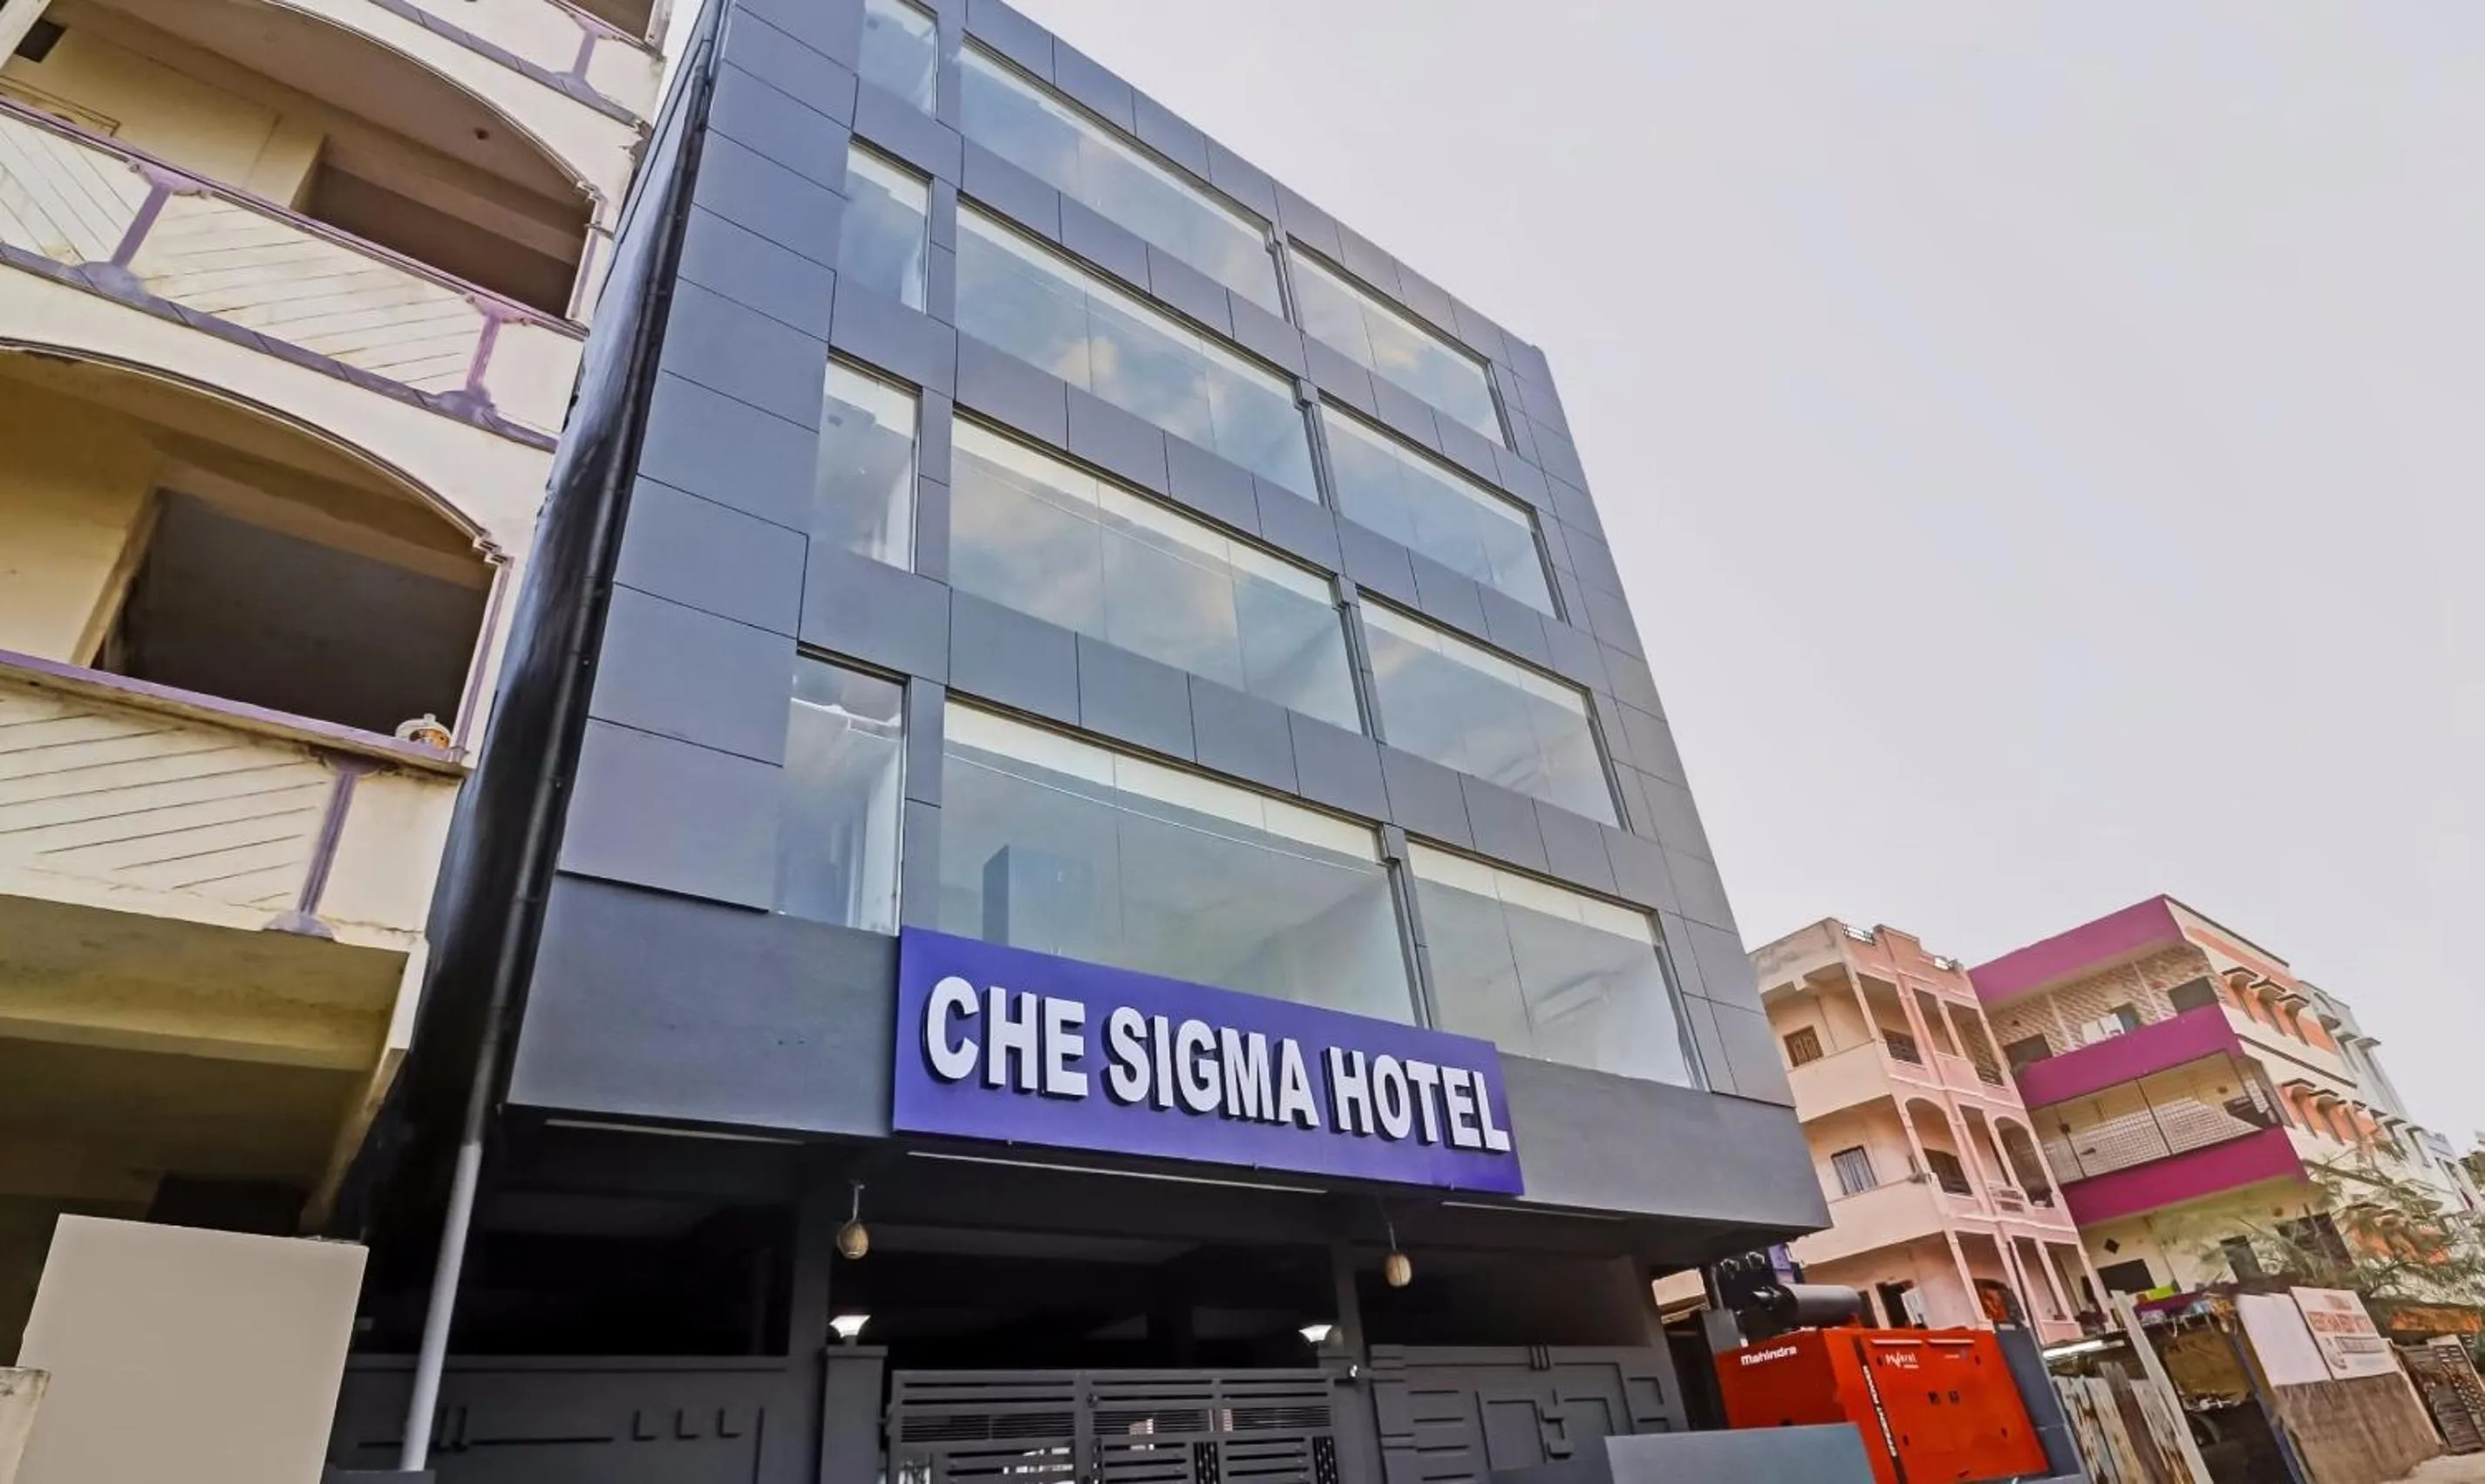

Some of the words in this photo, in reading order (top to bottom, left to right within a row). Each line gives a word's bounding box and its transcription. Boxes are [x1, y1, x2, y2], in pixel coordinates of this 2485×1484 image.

[925, 976, 1089, 1097] CHE
[1106, 1006, 1321, 1127] SIGMA
[1327, 1046, 1512, 1152] HOTEL
